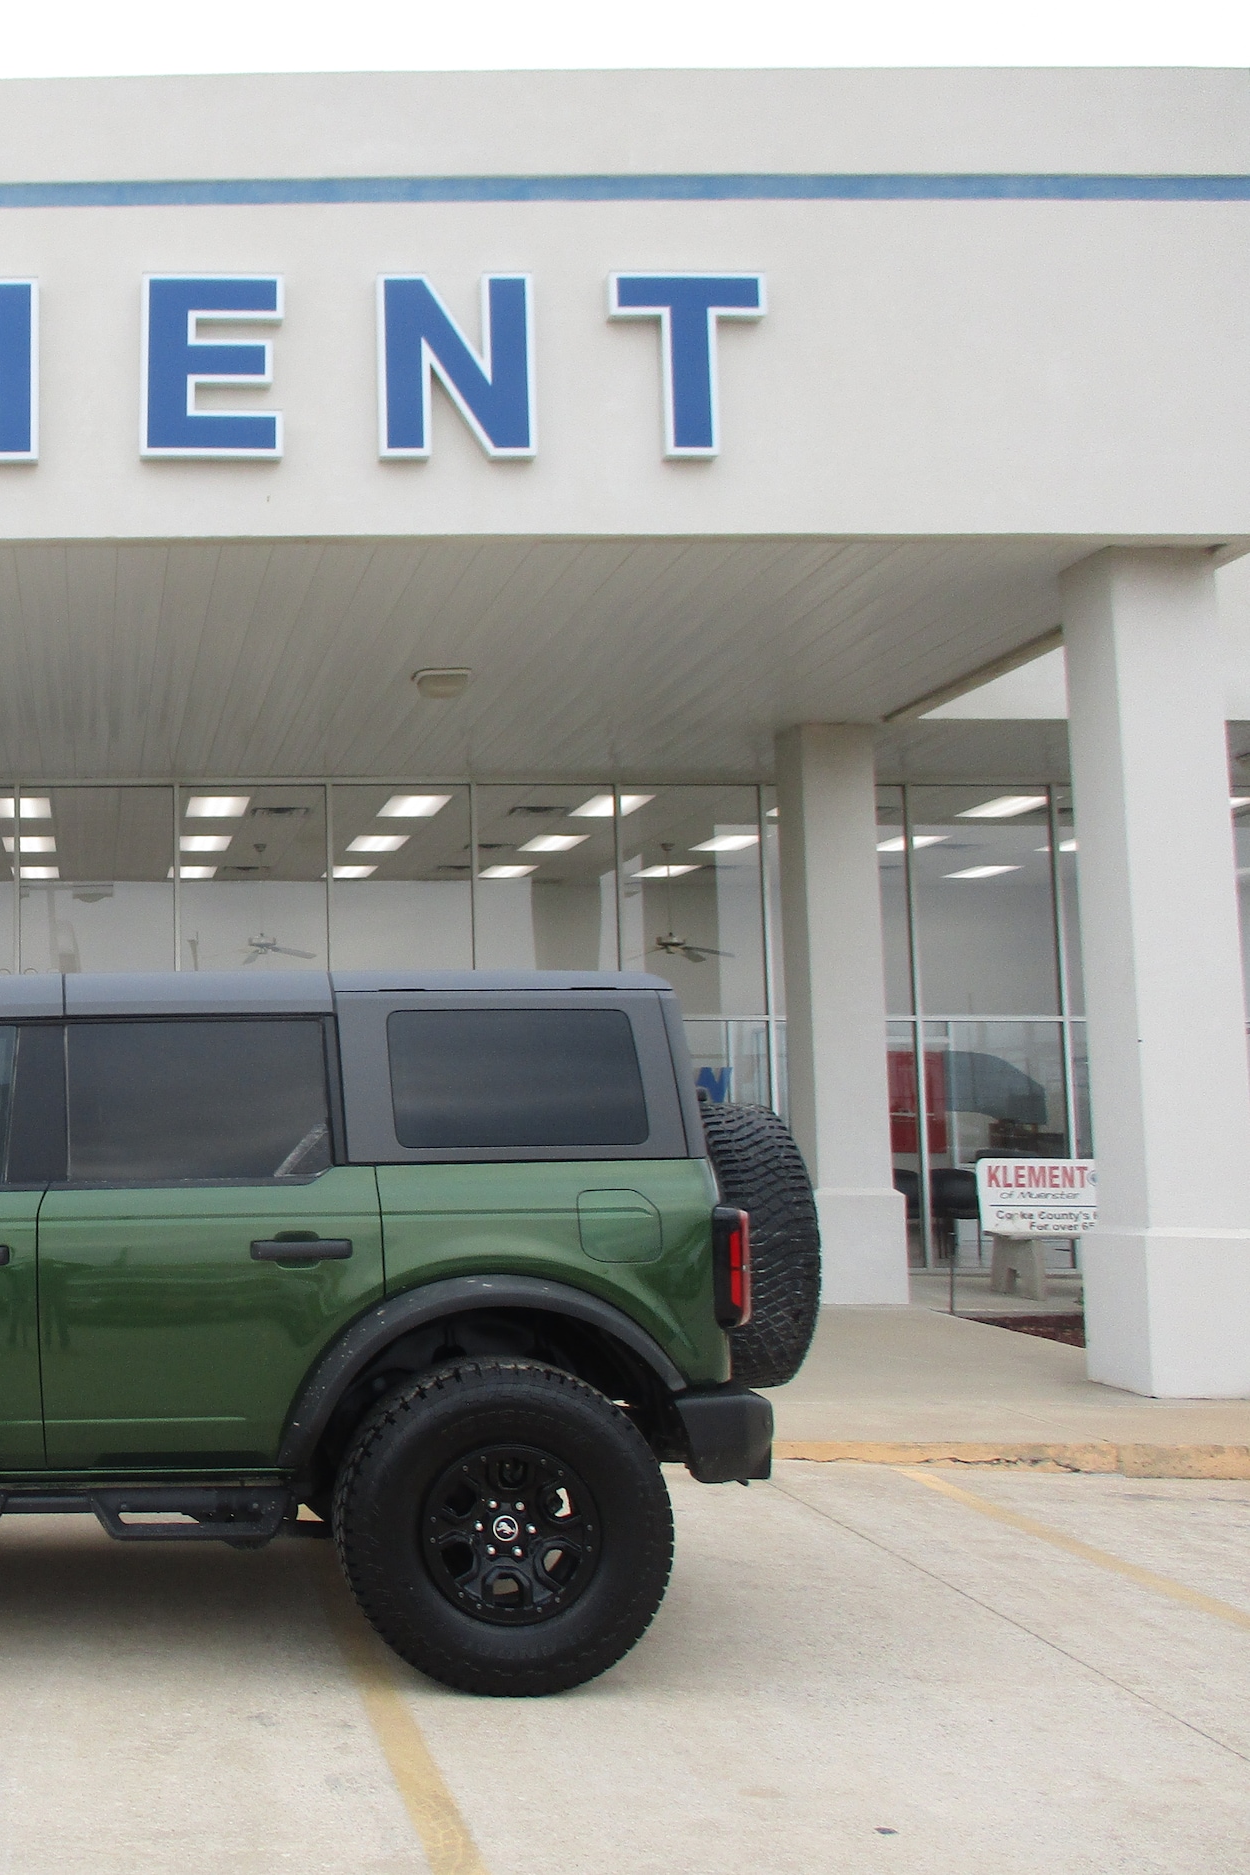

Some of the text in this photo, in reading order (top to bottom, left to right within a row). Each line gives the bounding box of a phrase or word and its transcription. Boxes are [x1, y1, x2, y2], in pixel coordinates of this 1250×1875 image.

[987, 1165, 1088, 1188] KLEMENT
[999, 1191, 1080, 1200] of Muenster
[1038, 1210, 1090, 1222] County's
[1052, 1223, 1078, 1231] over
